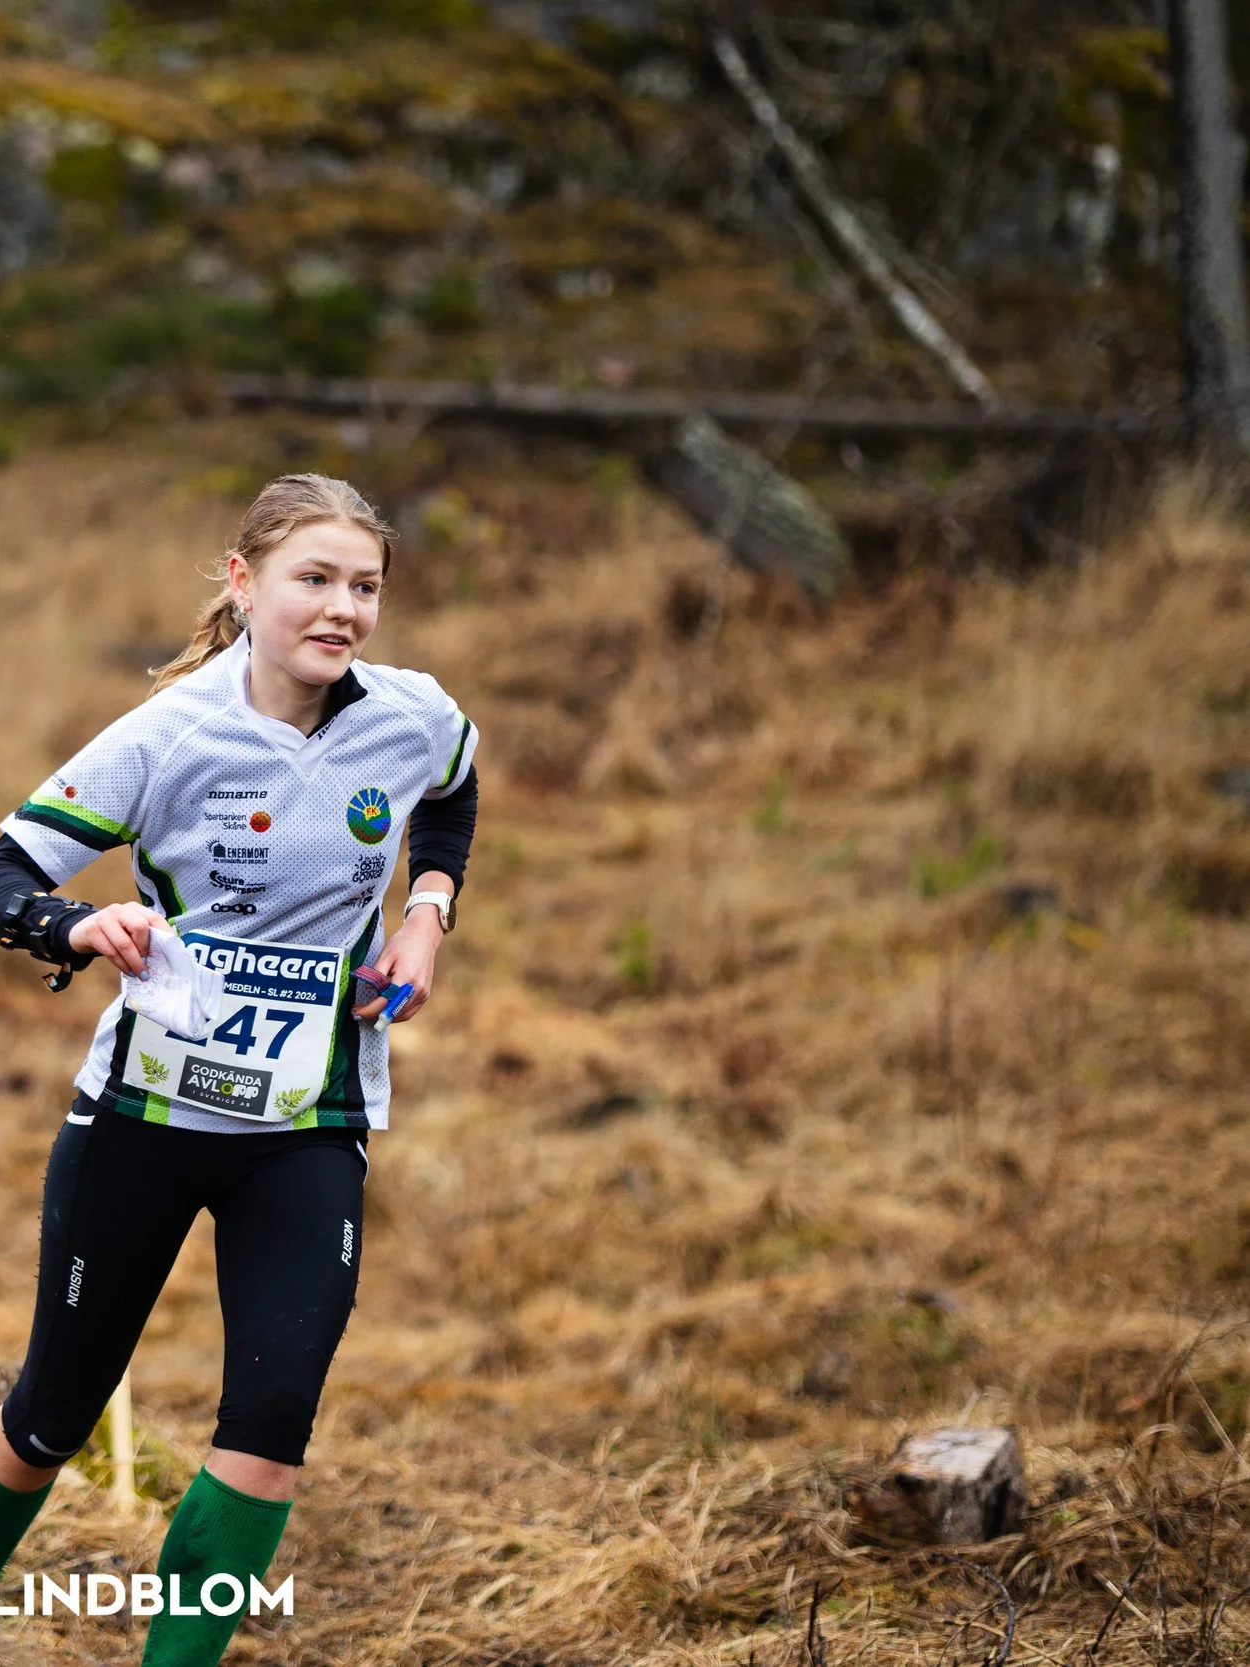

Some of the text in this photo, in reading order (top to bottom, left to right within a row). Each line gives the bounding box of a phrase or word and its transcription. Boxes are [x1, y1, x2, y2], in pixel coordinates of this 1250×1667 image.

[207, 790, 268, 800] noname
[204, 812, 247, 822] Sparbanken
[185, 942, 337, 983] agheera
[267, 988, 278, 997] SL
[279, 990, 294, 999] #2
[295, 991, 317, 1001] 2026
[165, 1005, 305, 1060] 47
[190, 1064, 262, 1087] GODKÄNDA
[199, 1090, 236, 1105] SVERIGE
[341, 1220, 354, 1267] FUSION
[67, 1256, 84, 1307] FUSION
